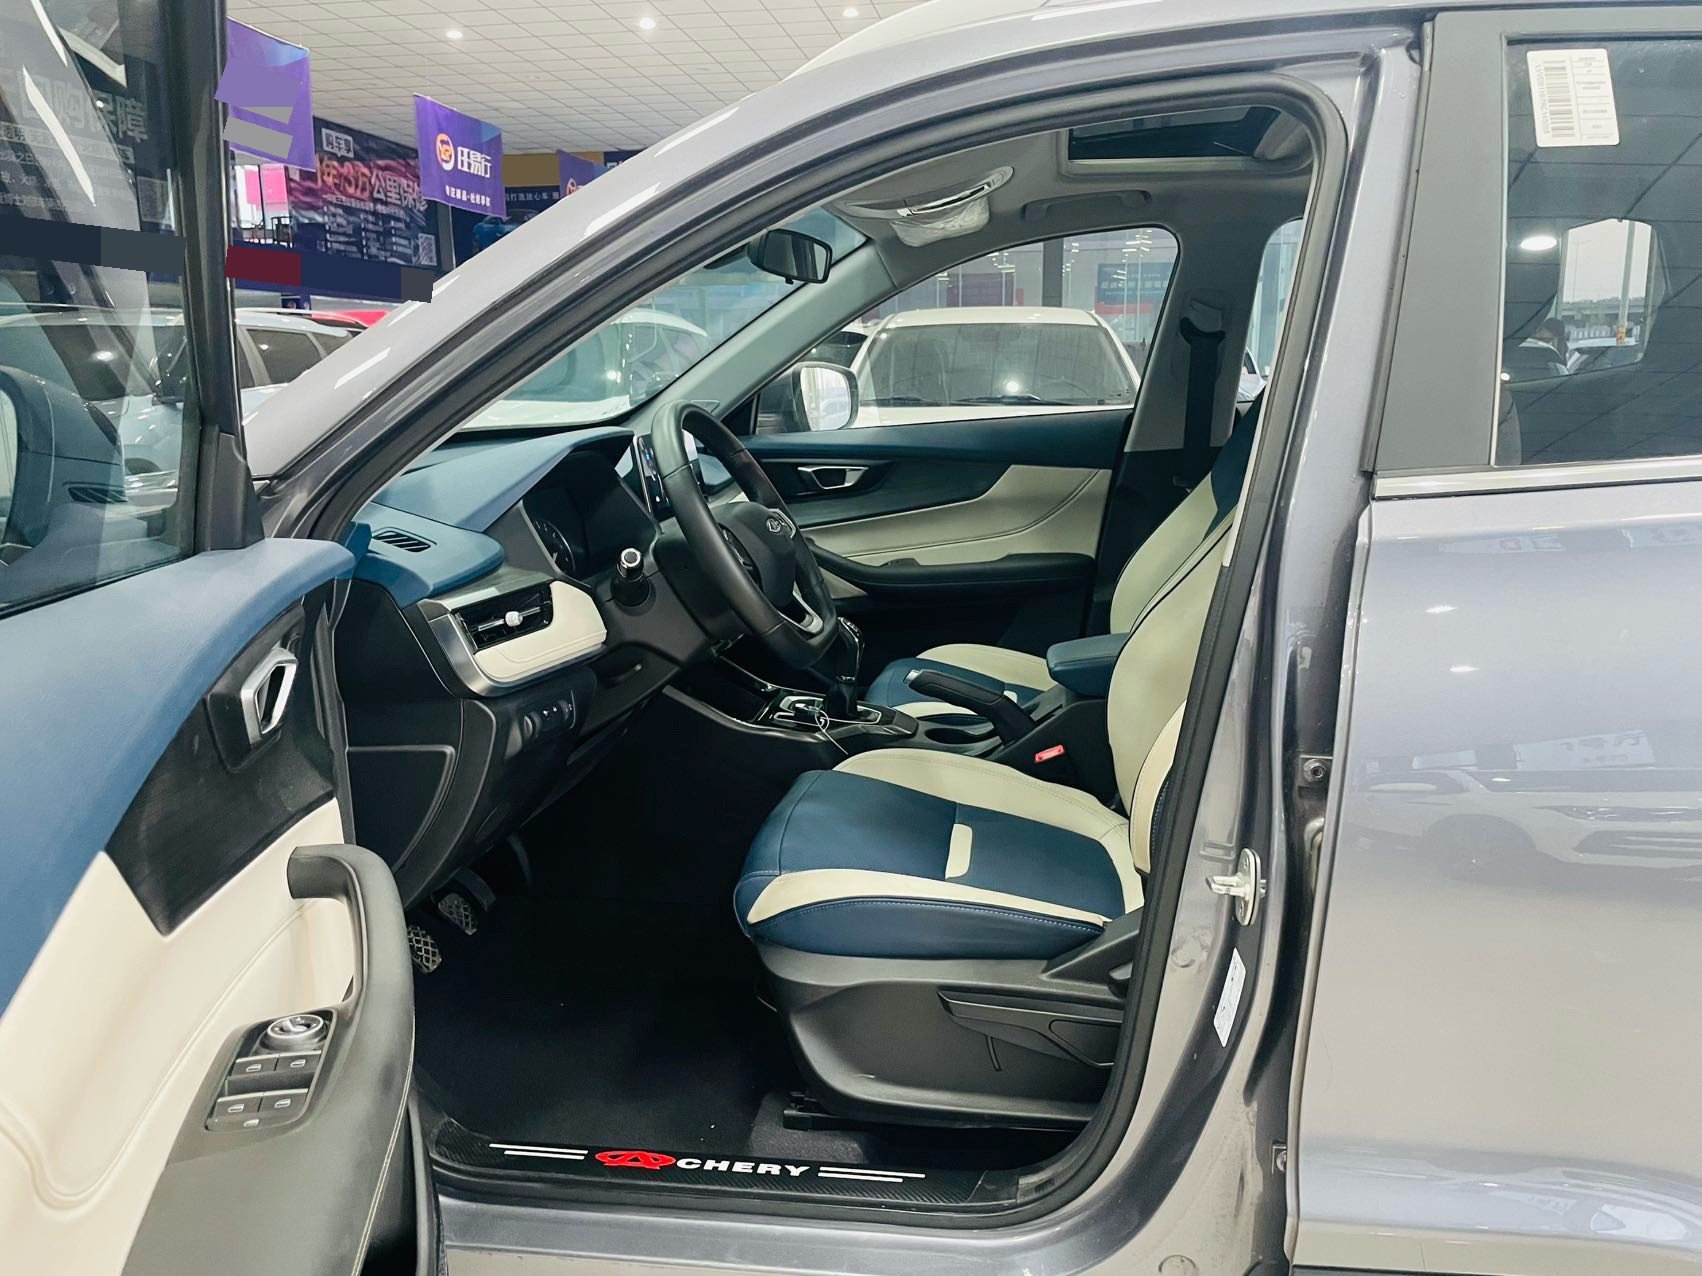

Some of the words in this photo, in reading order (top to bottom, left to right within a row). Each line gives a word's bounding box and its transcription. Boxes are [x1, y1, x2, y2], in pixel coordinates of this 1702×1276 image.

[325, 132, 353, 155] 购车享
[676, 1158, 811, 1177] CHERY
